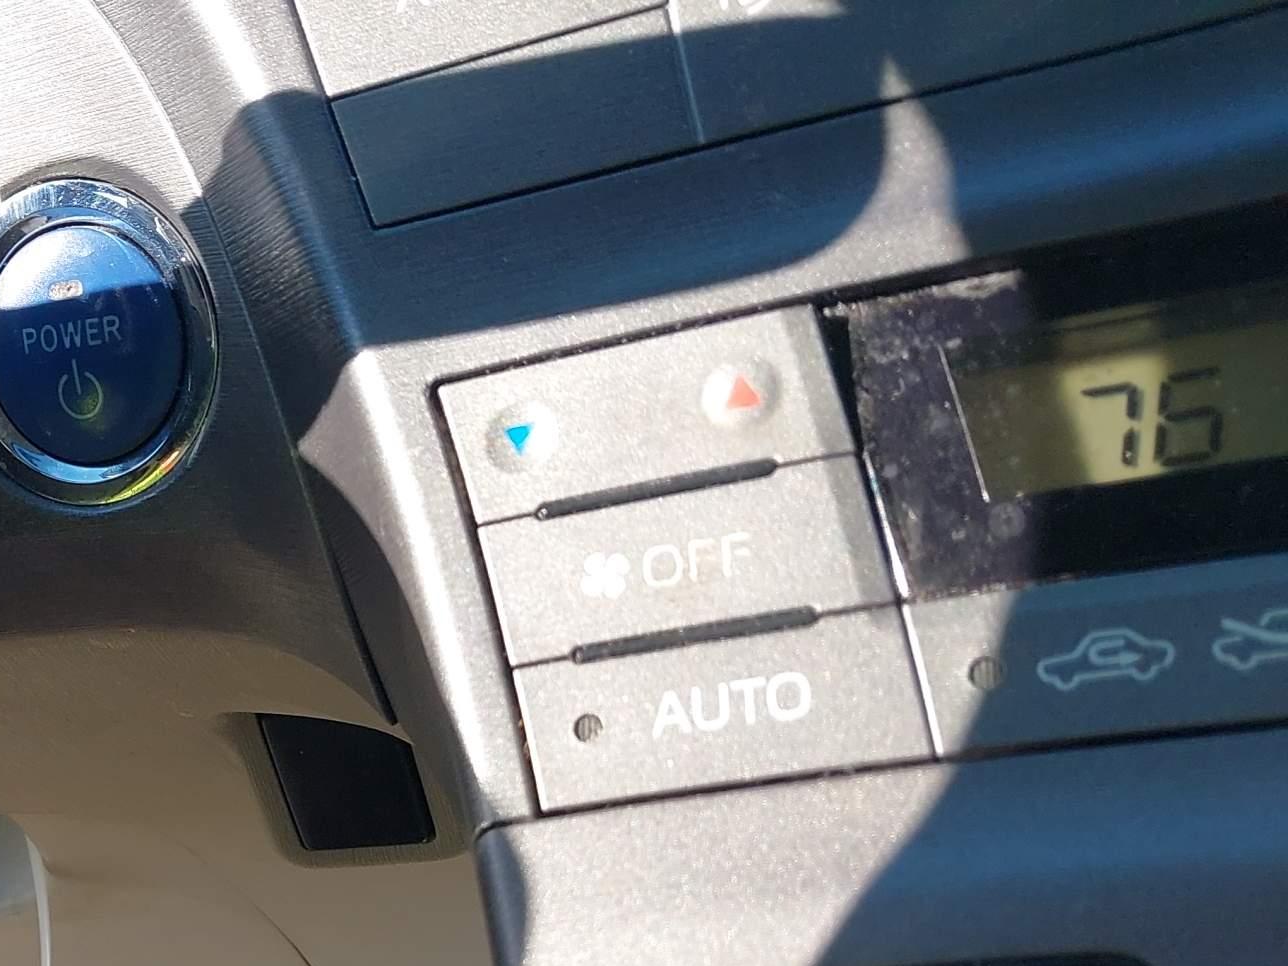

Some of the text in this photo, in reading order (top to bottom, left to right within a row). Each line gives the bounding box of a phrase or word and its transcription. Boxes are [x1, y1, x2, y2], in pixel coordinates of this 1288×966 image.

[21, 314, 122, 354] POWER
[1079, 365, 1223, 468] 76
[642, 532, 752, 589] OFF
[651, 670, 812, 739] AUTO
